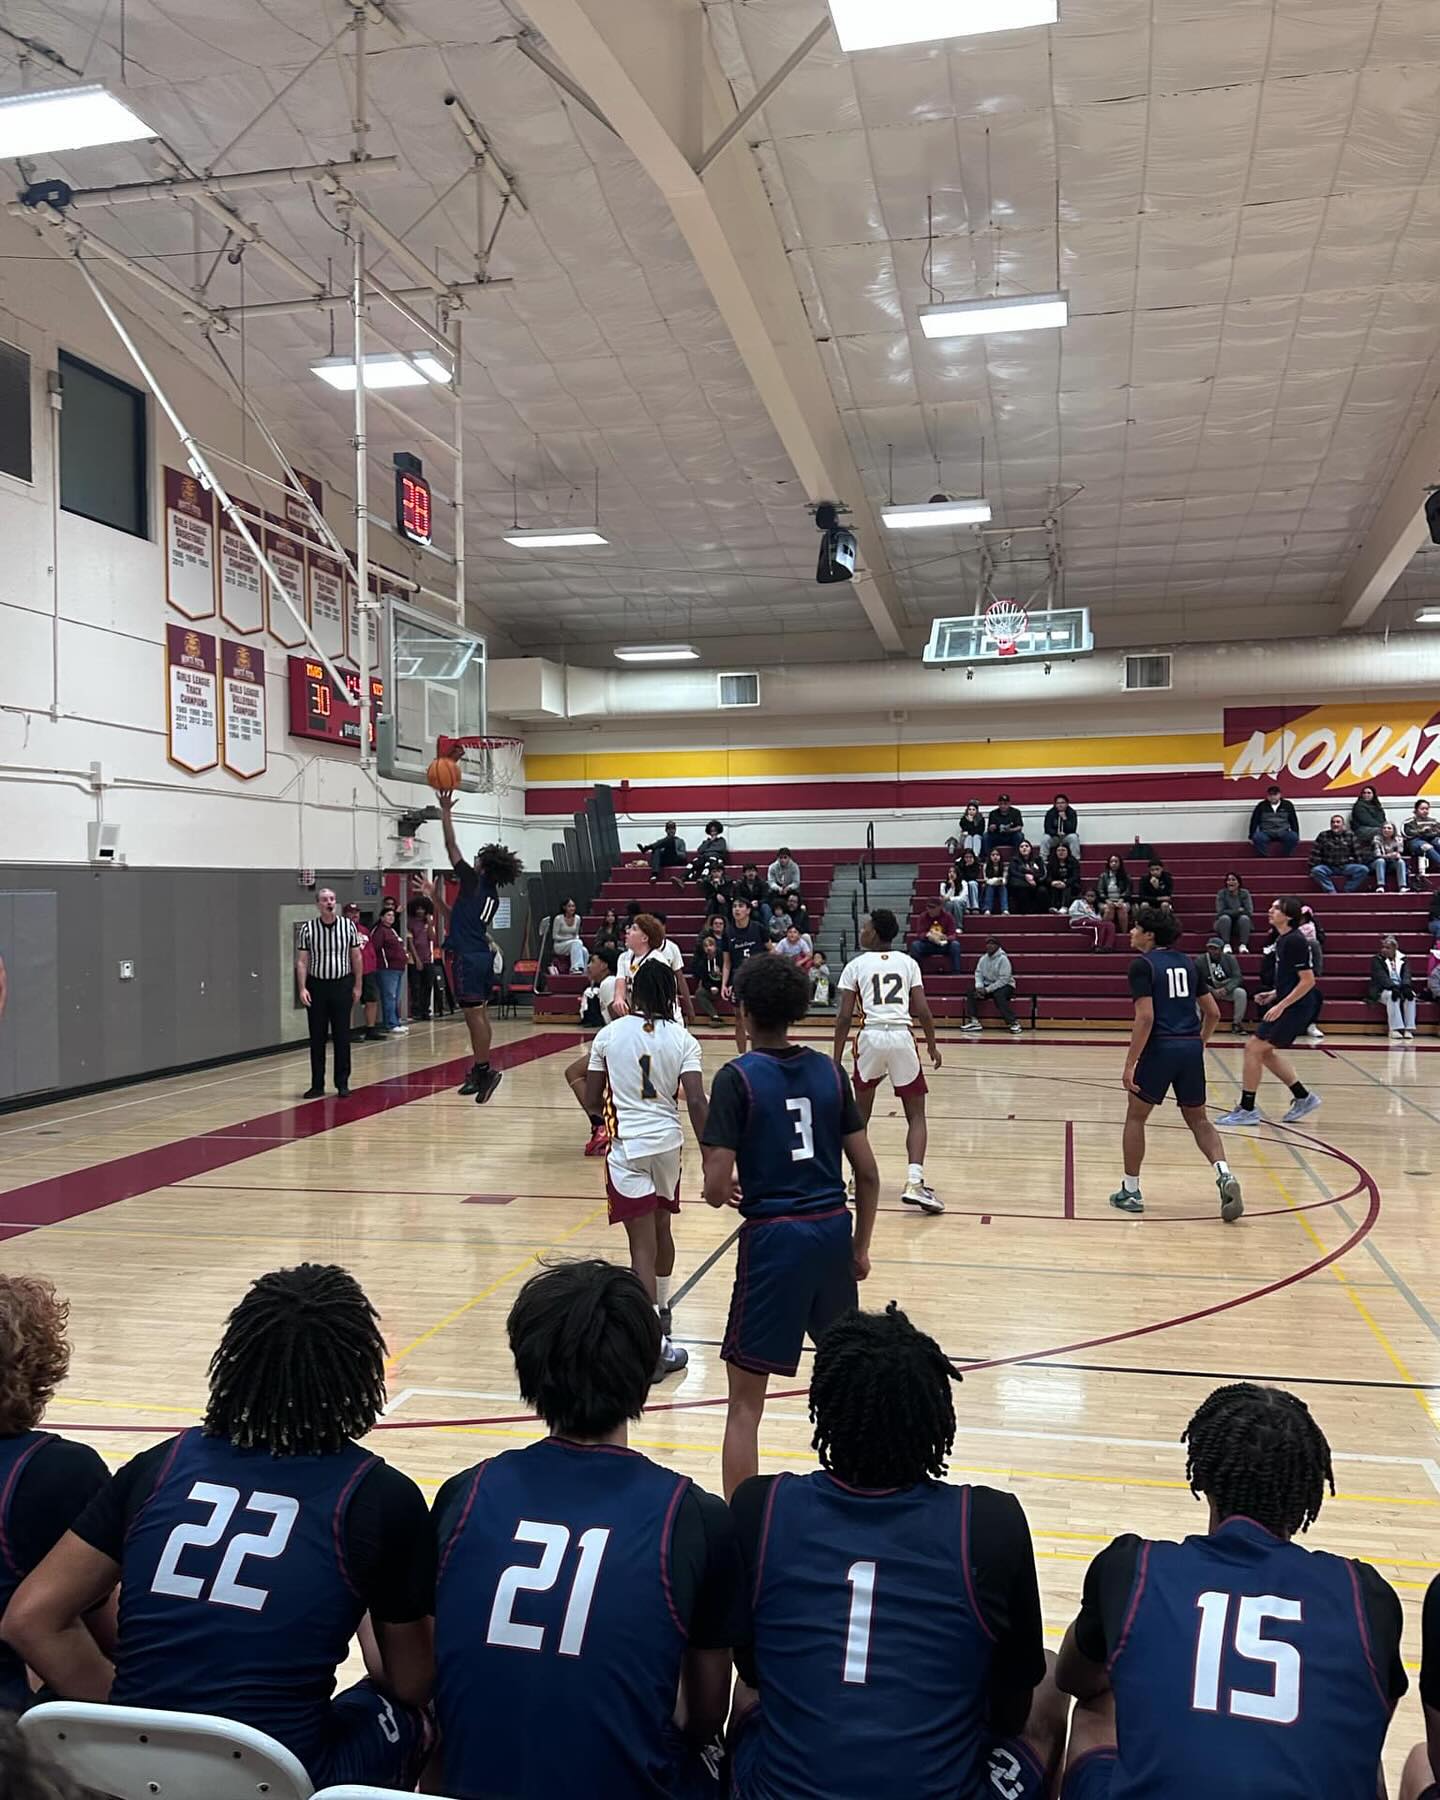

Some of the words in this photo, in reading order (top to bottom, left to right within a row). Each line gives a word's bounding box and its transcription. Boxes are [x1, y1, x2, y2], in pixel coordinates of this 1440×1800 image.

[176, 671, 191, 684] GIRLS
[192, 674, 210, 687] LEAGUE
[312, 683, 330, 716] 30
[872, 973, 904, 1005] 12
[1166, 967, 1190, 998] 10
[638, 1053, 657, 1099] 1
[785, 1097, 815, 1161] 3
[150, 1481, 300, 1612] 22
[486, 1519, 610, 1656] 21
[842, 1561, 877, 1684] 1
[1192, 1590, 1302, 1724] 15
